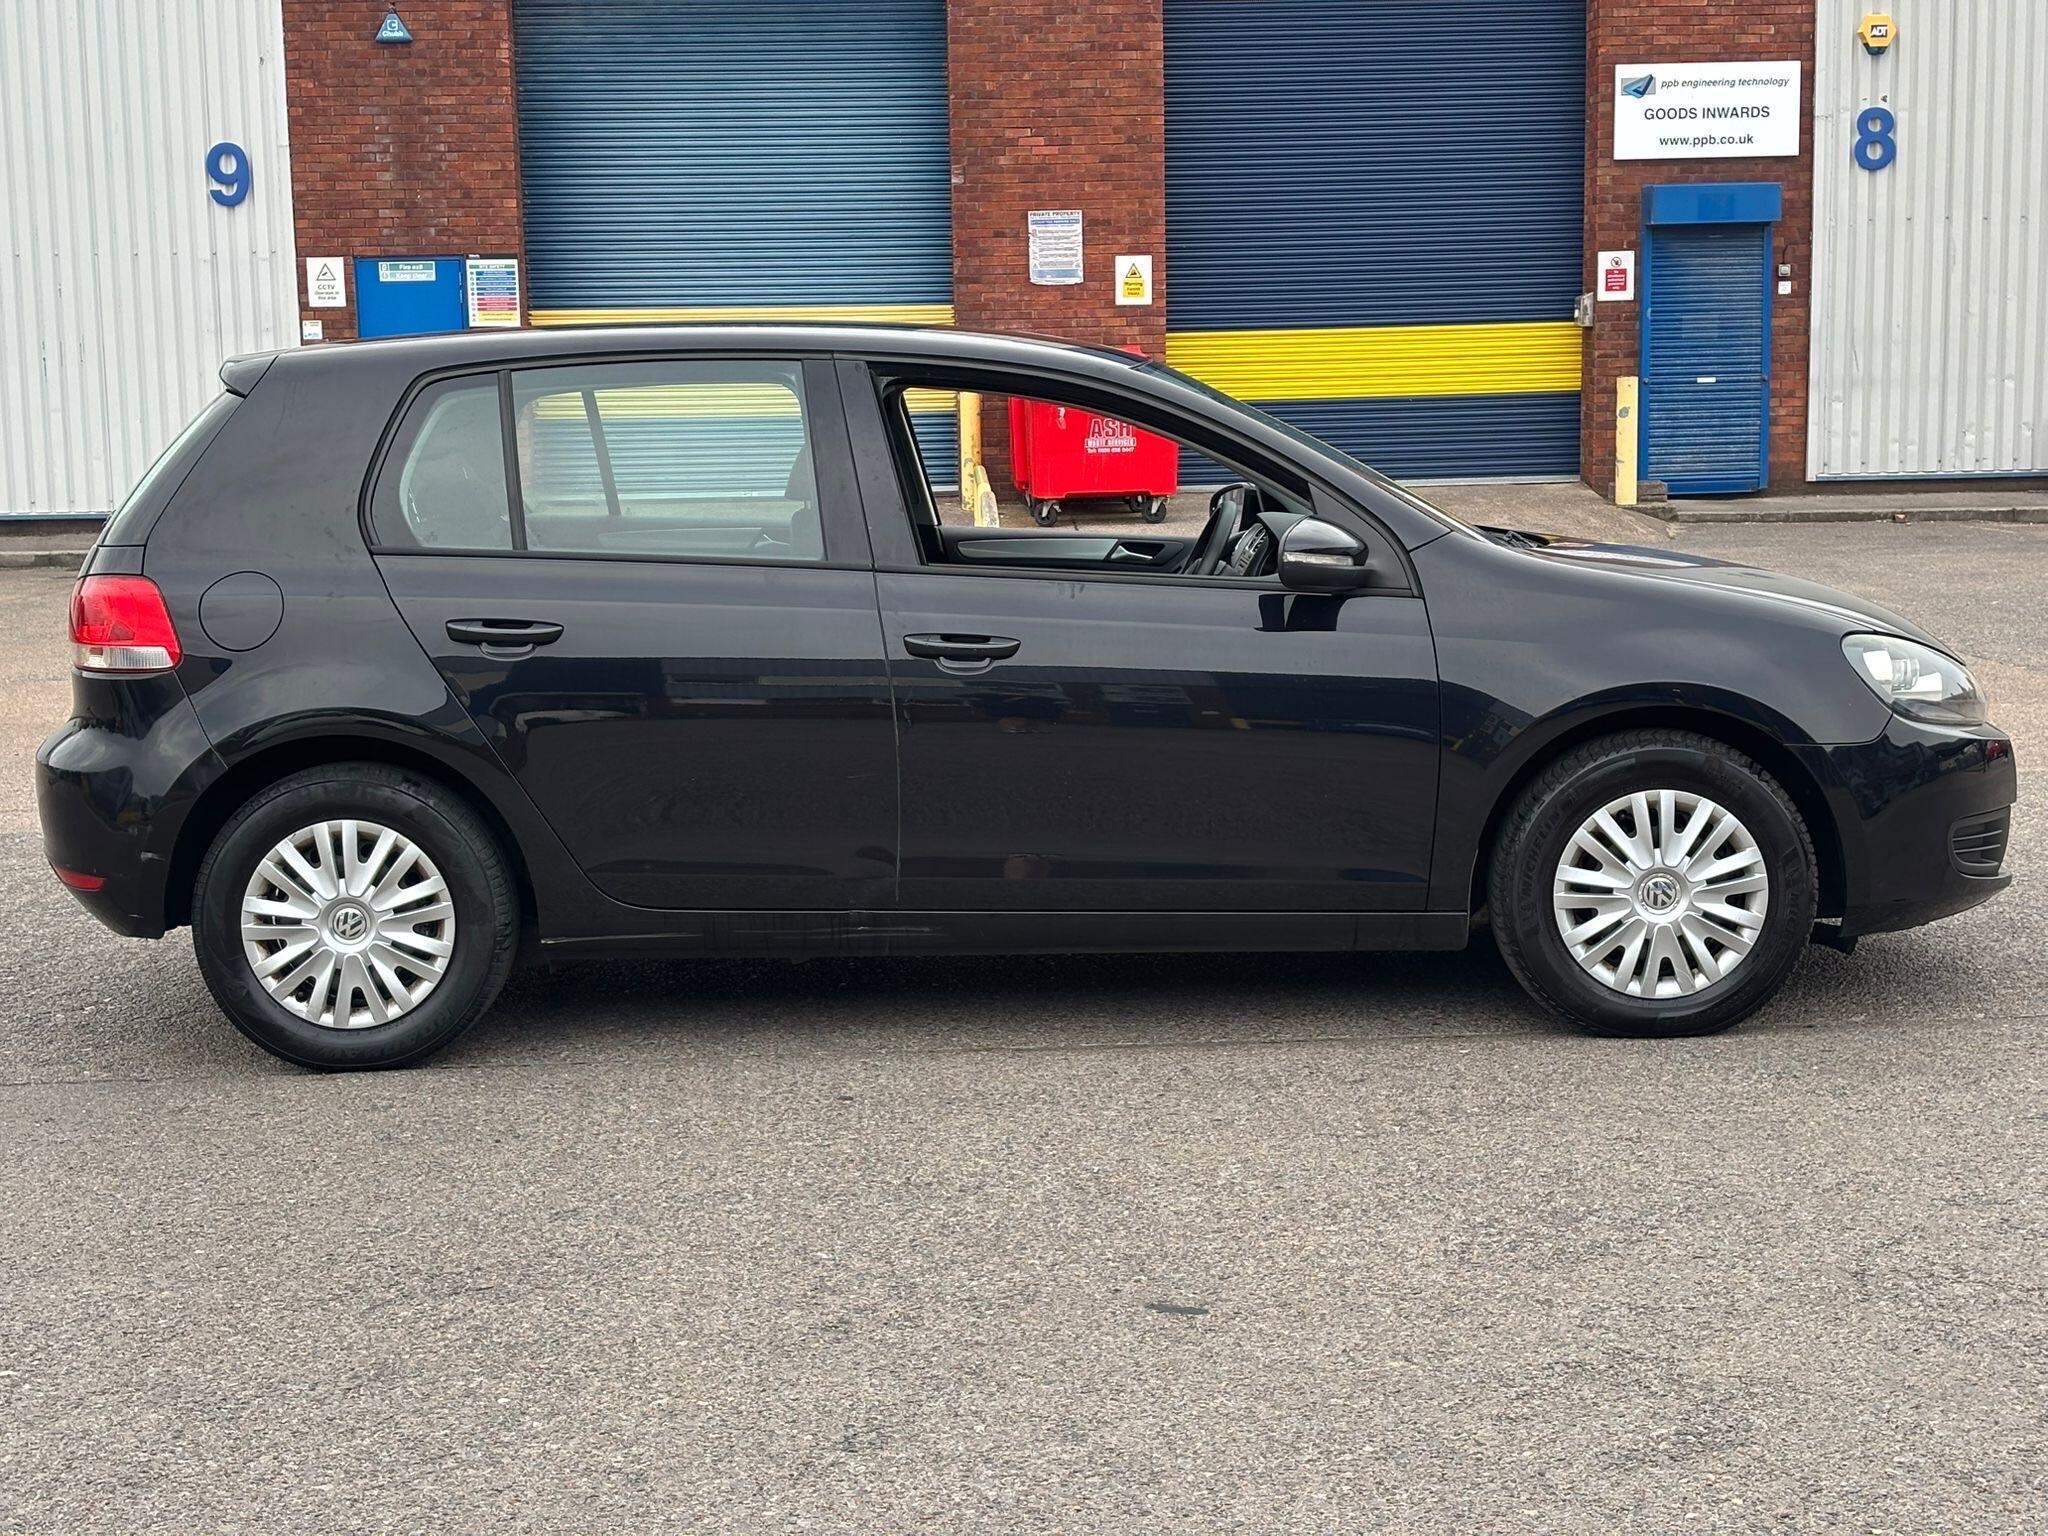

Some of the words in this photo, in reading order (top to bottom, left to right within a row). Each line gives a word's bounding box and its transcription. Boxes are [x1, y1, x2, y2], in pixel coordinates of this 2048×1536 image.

[1871, 26, 1888, 37] ADT
[1661, 79, 1679, 89] ppb
[1681, 79, 1736, 89] engineering
[1738, 77, 1790, 88] technology
[1644, 107, 1698, 120] GOODS
[1702, 106, 1770, 119] INWARDS
[1659, 133, 1754, 148] www.ppb.co.uk
[1854, 107, 1897, 171] 8
[206, 142, 249, 207] 9
[1090, 418, 1132, 438] ASH
